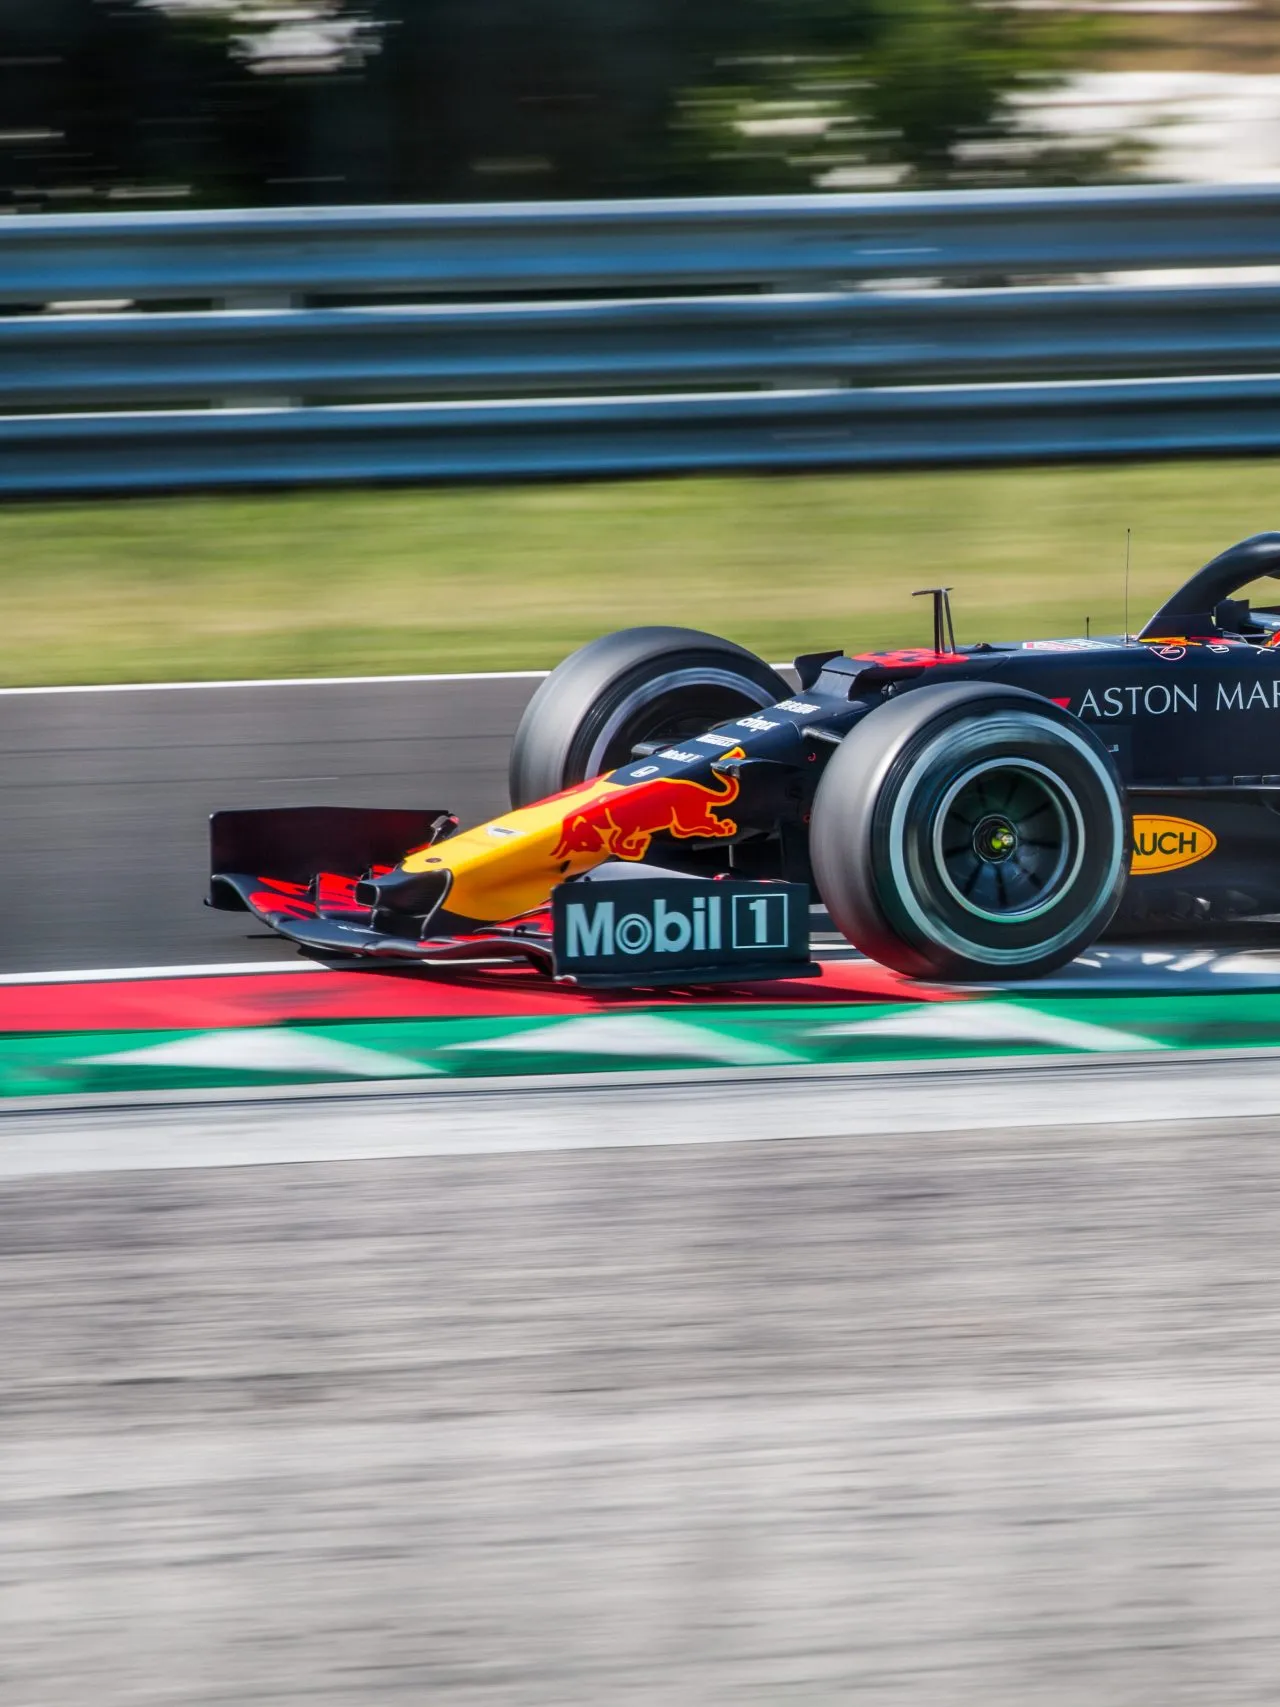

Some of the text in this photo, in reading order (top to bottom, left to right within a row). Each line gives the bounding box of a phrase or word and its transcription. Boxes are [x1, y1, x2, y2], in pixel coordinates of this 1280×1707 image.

[1078, 684, 1197, 718] ASTON
[566, 896, 769, 957] Mobil 1
